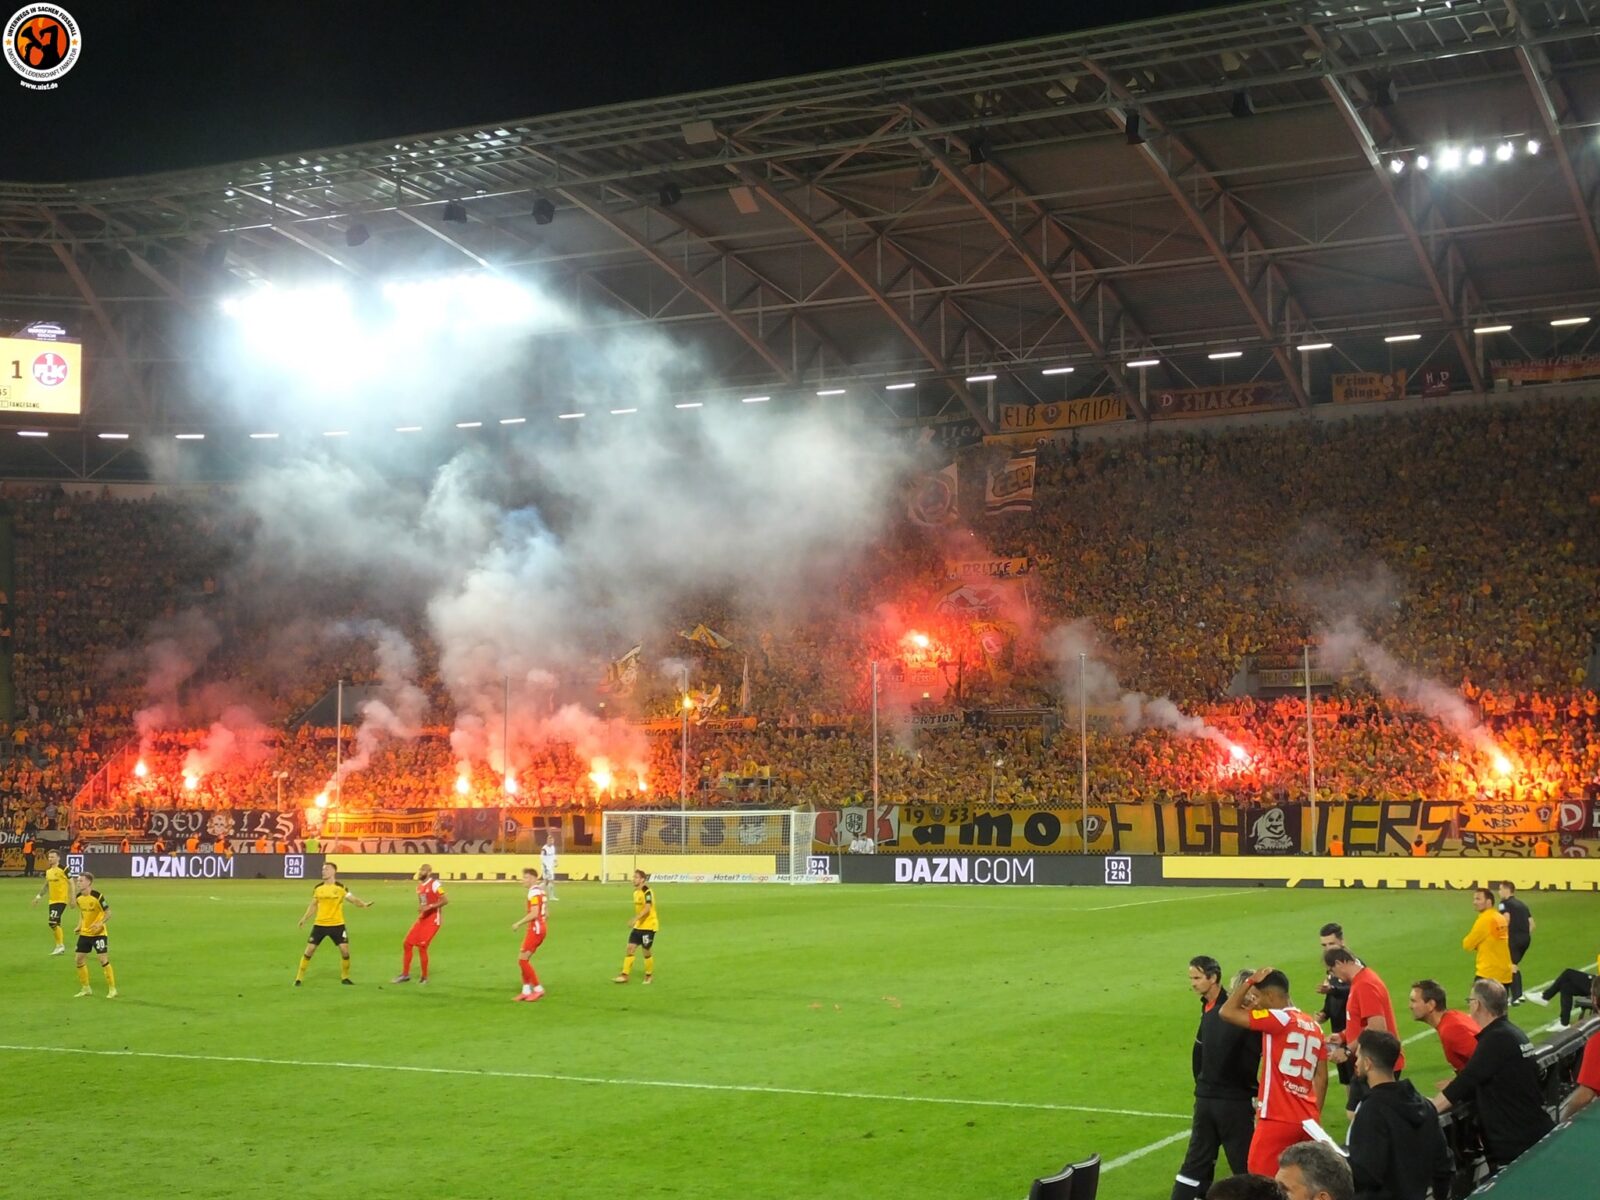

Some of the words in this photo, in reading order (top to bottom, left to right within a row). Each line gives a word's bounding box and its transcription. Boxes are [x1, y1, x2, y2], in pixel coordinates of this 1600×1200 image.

[12, 360, 22, 379] 1
[1005, 406, 1036, 427] ELB
[1068, 399, 1123, 424] KAIDA
[904, 808, 925, 823] 19
[949, 807, 969, 823] 53
[1473, 803, 1530, 815] DRESDEN
[131, 855, 235, 878] DAZN.COM
[895, 857, 1034, 884] DAZN.COM
[1111, 861, 1125, 870] DA
[1111, 870, 1125, 880] ZN
[95, 939, 106, 950] 30
[1278, 1032, 1322, 1081] 25
